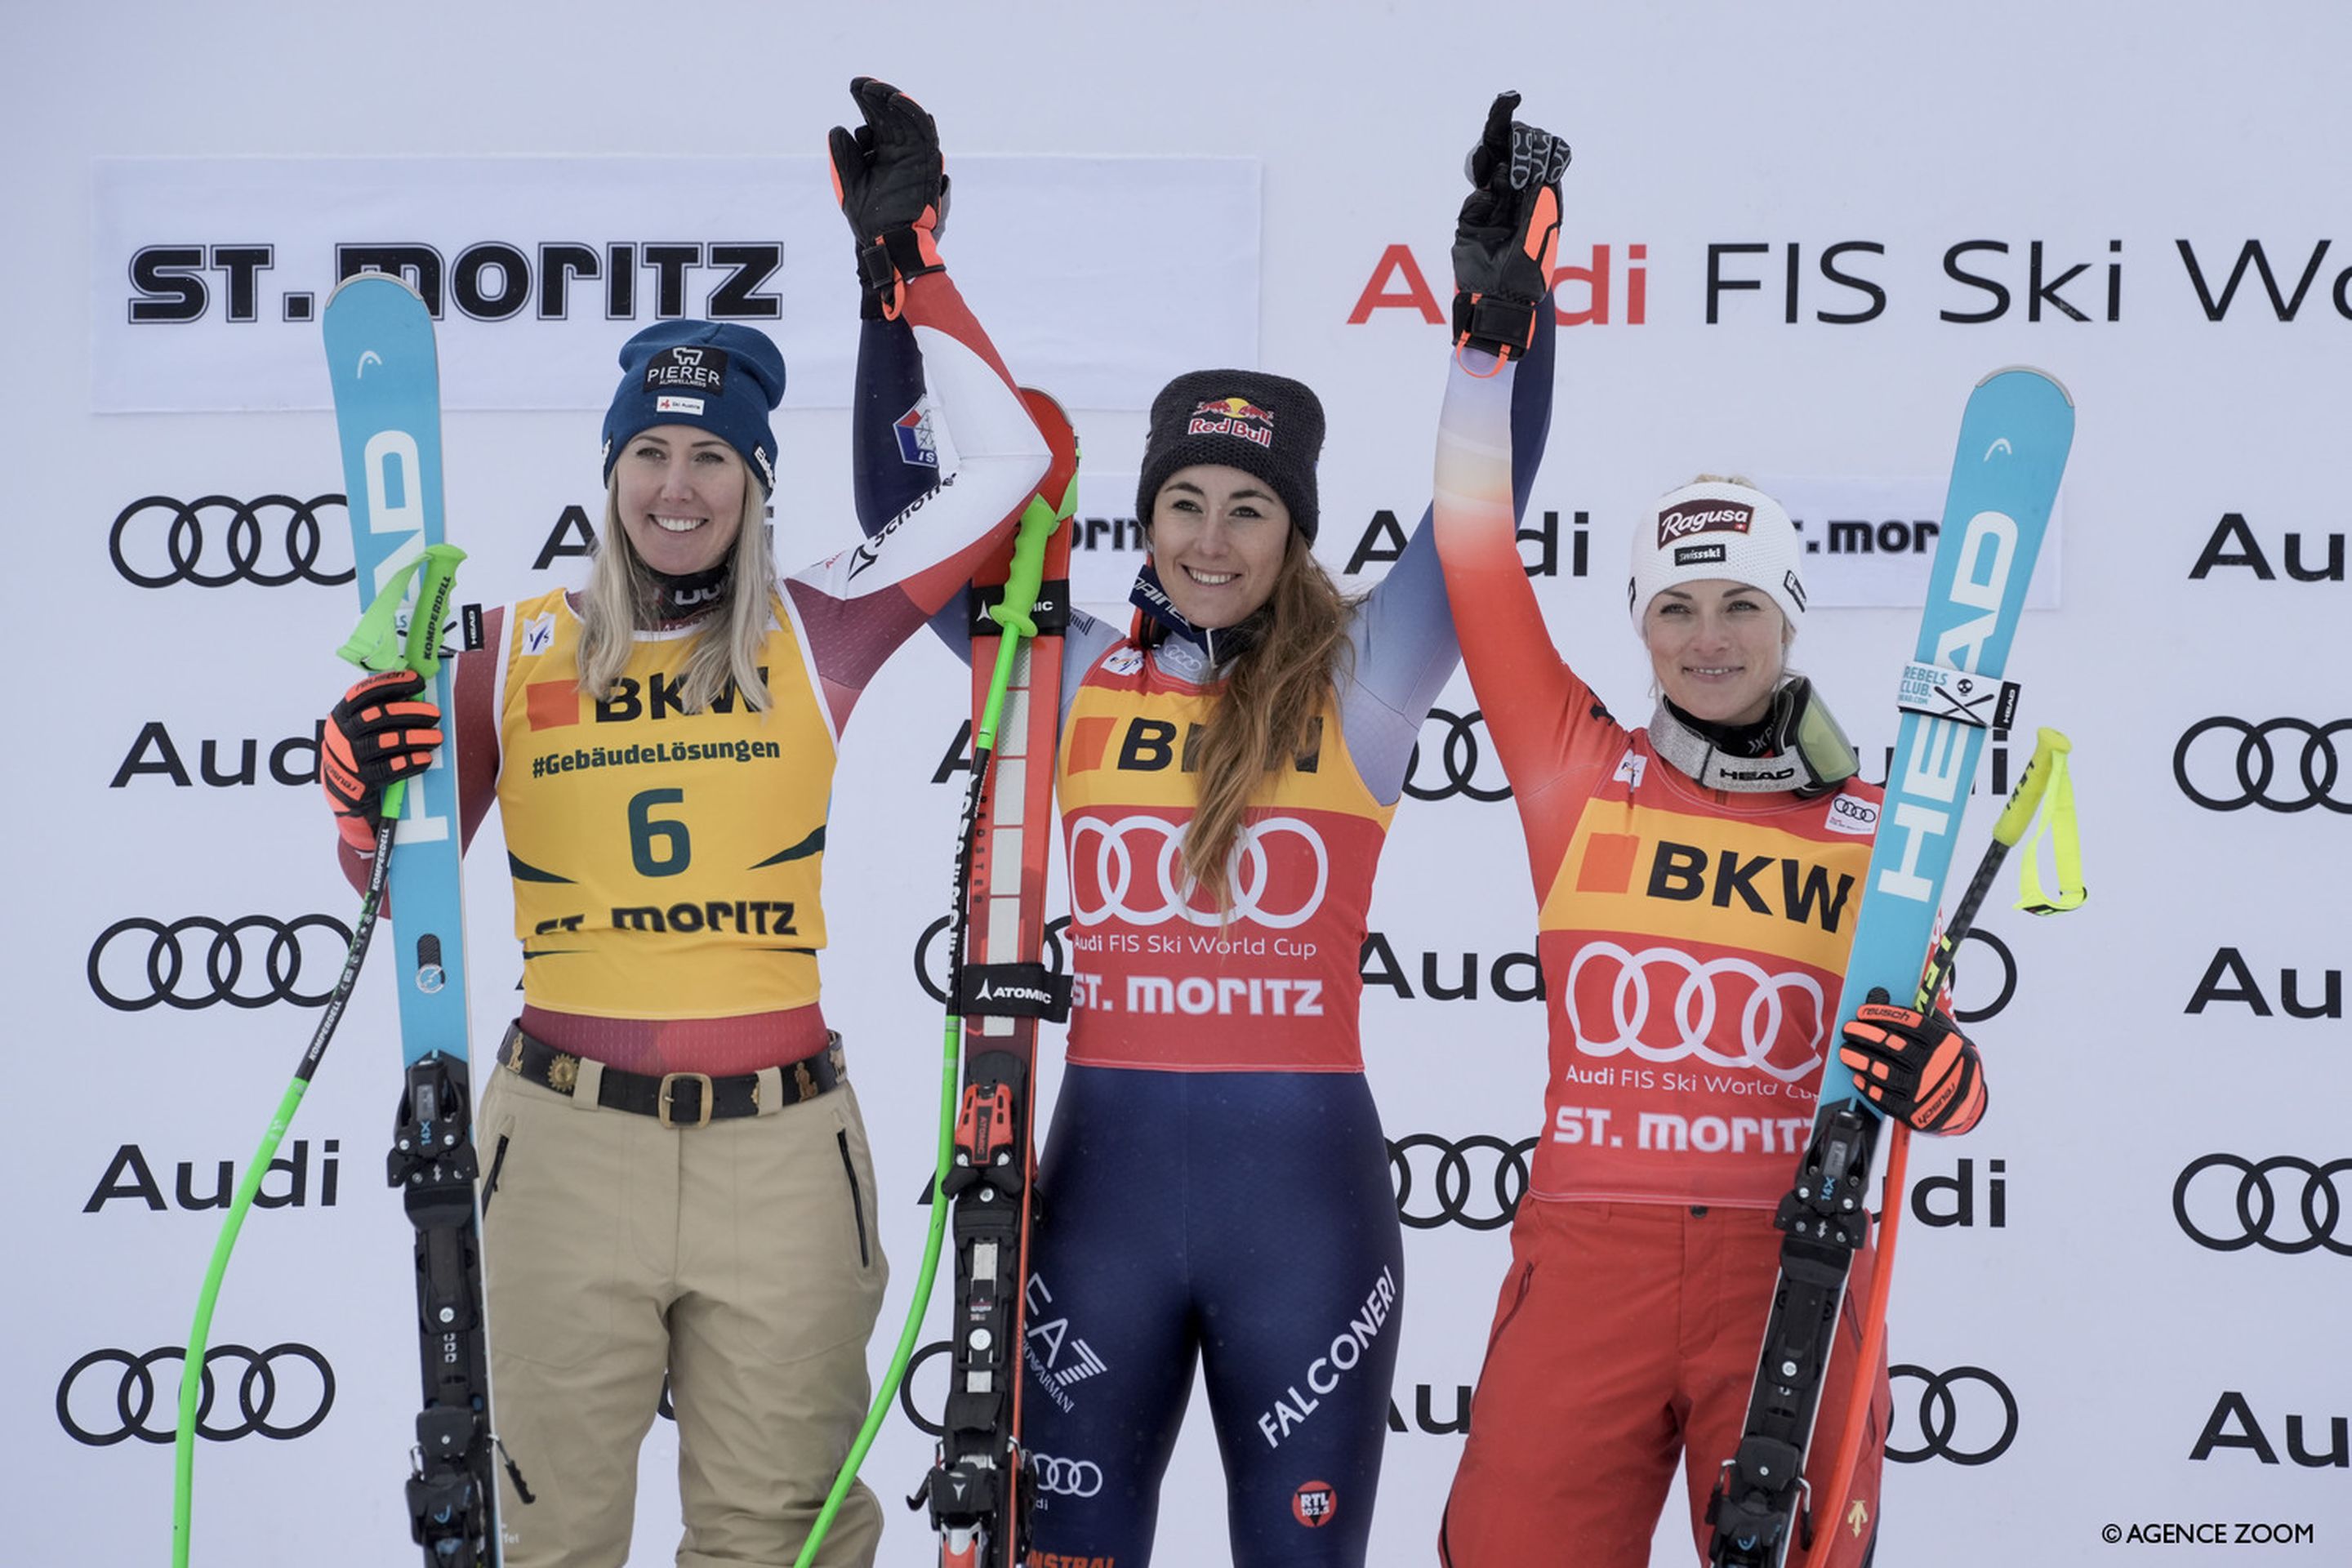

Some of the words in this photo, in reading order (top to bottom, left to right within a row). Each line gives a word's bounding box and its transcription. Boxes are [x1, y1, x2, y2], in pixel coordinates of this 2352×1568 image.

[127, 244, 314, 324] ST.
[1346, 243, 1647, 326] Adi
[1706, 240, 1887, 324] FIS
[1940, 239, 2123, 324] Ski
[647, 365, 721, 386] PIERER
[1187, 417, 1230, 436] Red
[1231, 419, 1273, 448] Bull
[1343, 510, 1588, 577] Adi
[1660, 509, 1749, 543] Ragusa
[424, 575, 452, 661] KOMPERDELL
[1903, 666, 1949, 686] REBELS
[2002, 688, 2017, 724] HEAD
[109, 719, 324, 788] Aud
[532, 739, 781, 778] #GebäudeLösungen
[1719, 767, 1795, 782] HEAD
[626, 787, 692, 878] 6
[372, 827, 390, 892] KOMPERDELL
[1646, 840, 1855, 933] BKW
[610, 900, 799, 936] MORITZ
[1073, 933, 1102, 952] Audi
[1108, 934, 1141, 953] FIS
[1147, 934, 1182, 954] Ski
[1187, 936, 1266, 956] World
[1273, 938, 1317, 960] Cup
[1359, 932, 1547, 1003] Aud
[991, 985, 1053, 1004] ATOMIC
[1071, 972, 1113, 1012] ST.
[1125, 974, 1325, 1017] MORITZ
[1860, 1006, 1911, 1022] reusch
[309, 1000, 342, 1062] KOMPERDELL
[1565, 1064, 1615, 1086] Audi
[1620, 1067, 1655, 1089] FIS
[1661, 1071, 1697, 1093] Ski
[1703, 1075, 1779, 1097] World
[1917, 1082, 1957, 1125] reusch
[1552, 1104, 1624, 1148] ST.
[82, 1139, 340, 1214] Audi
[1257, 1266, 1398, 1449] FALCONERI
[1300, 1492, 1330, 1508] RTL
[1301, 1505, 1330, 1517] 102.5
